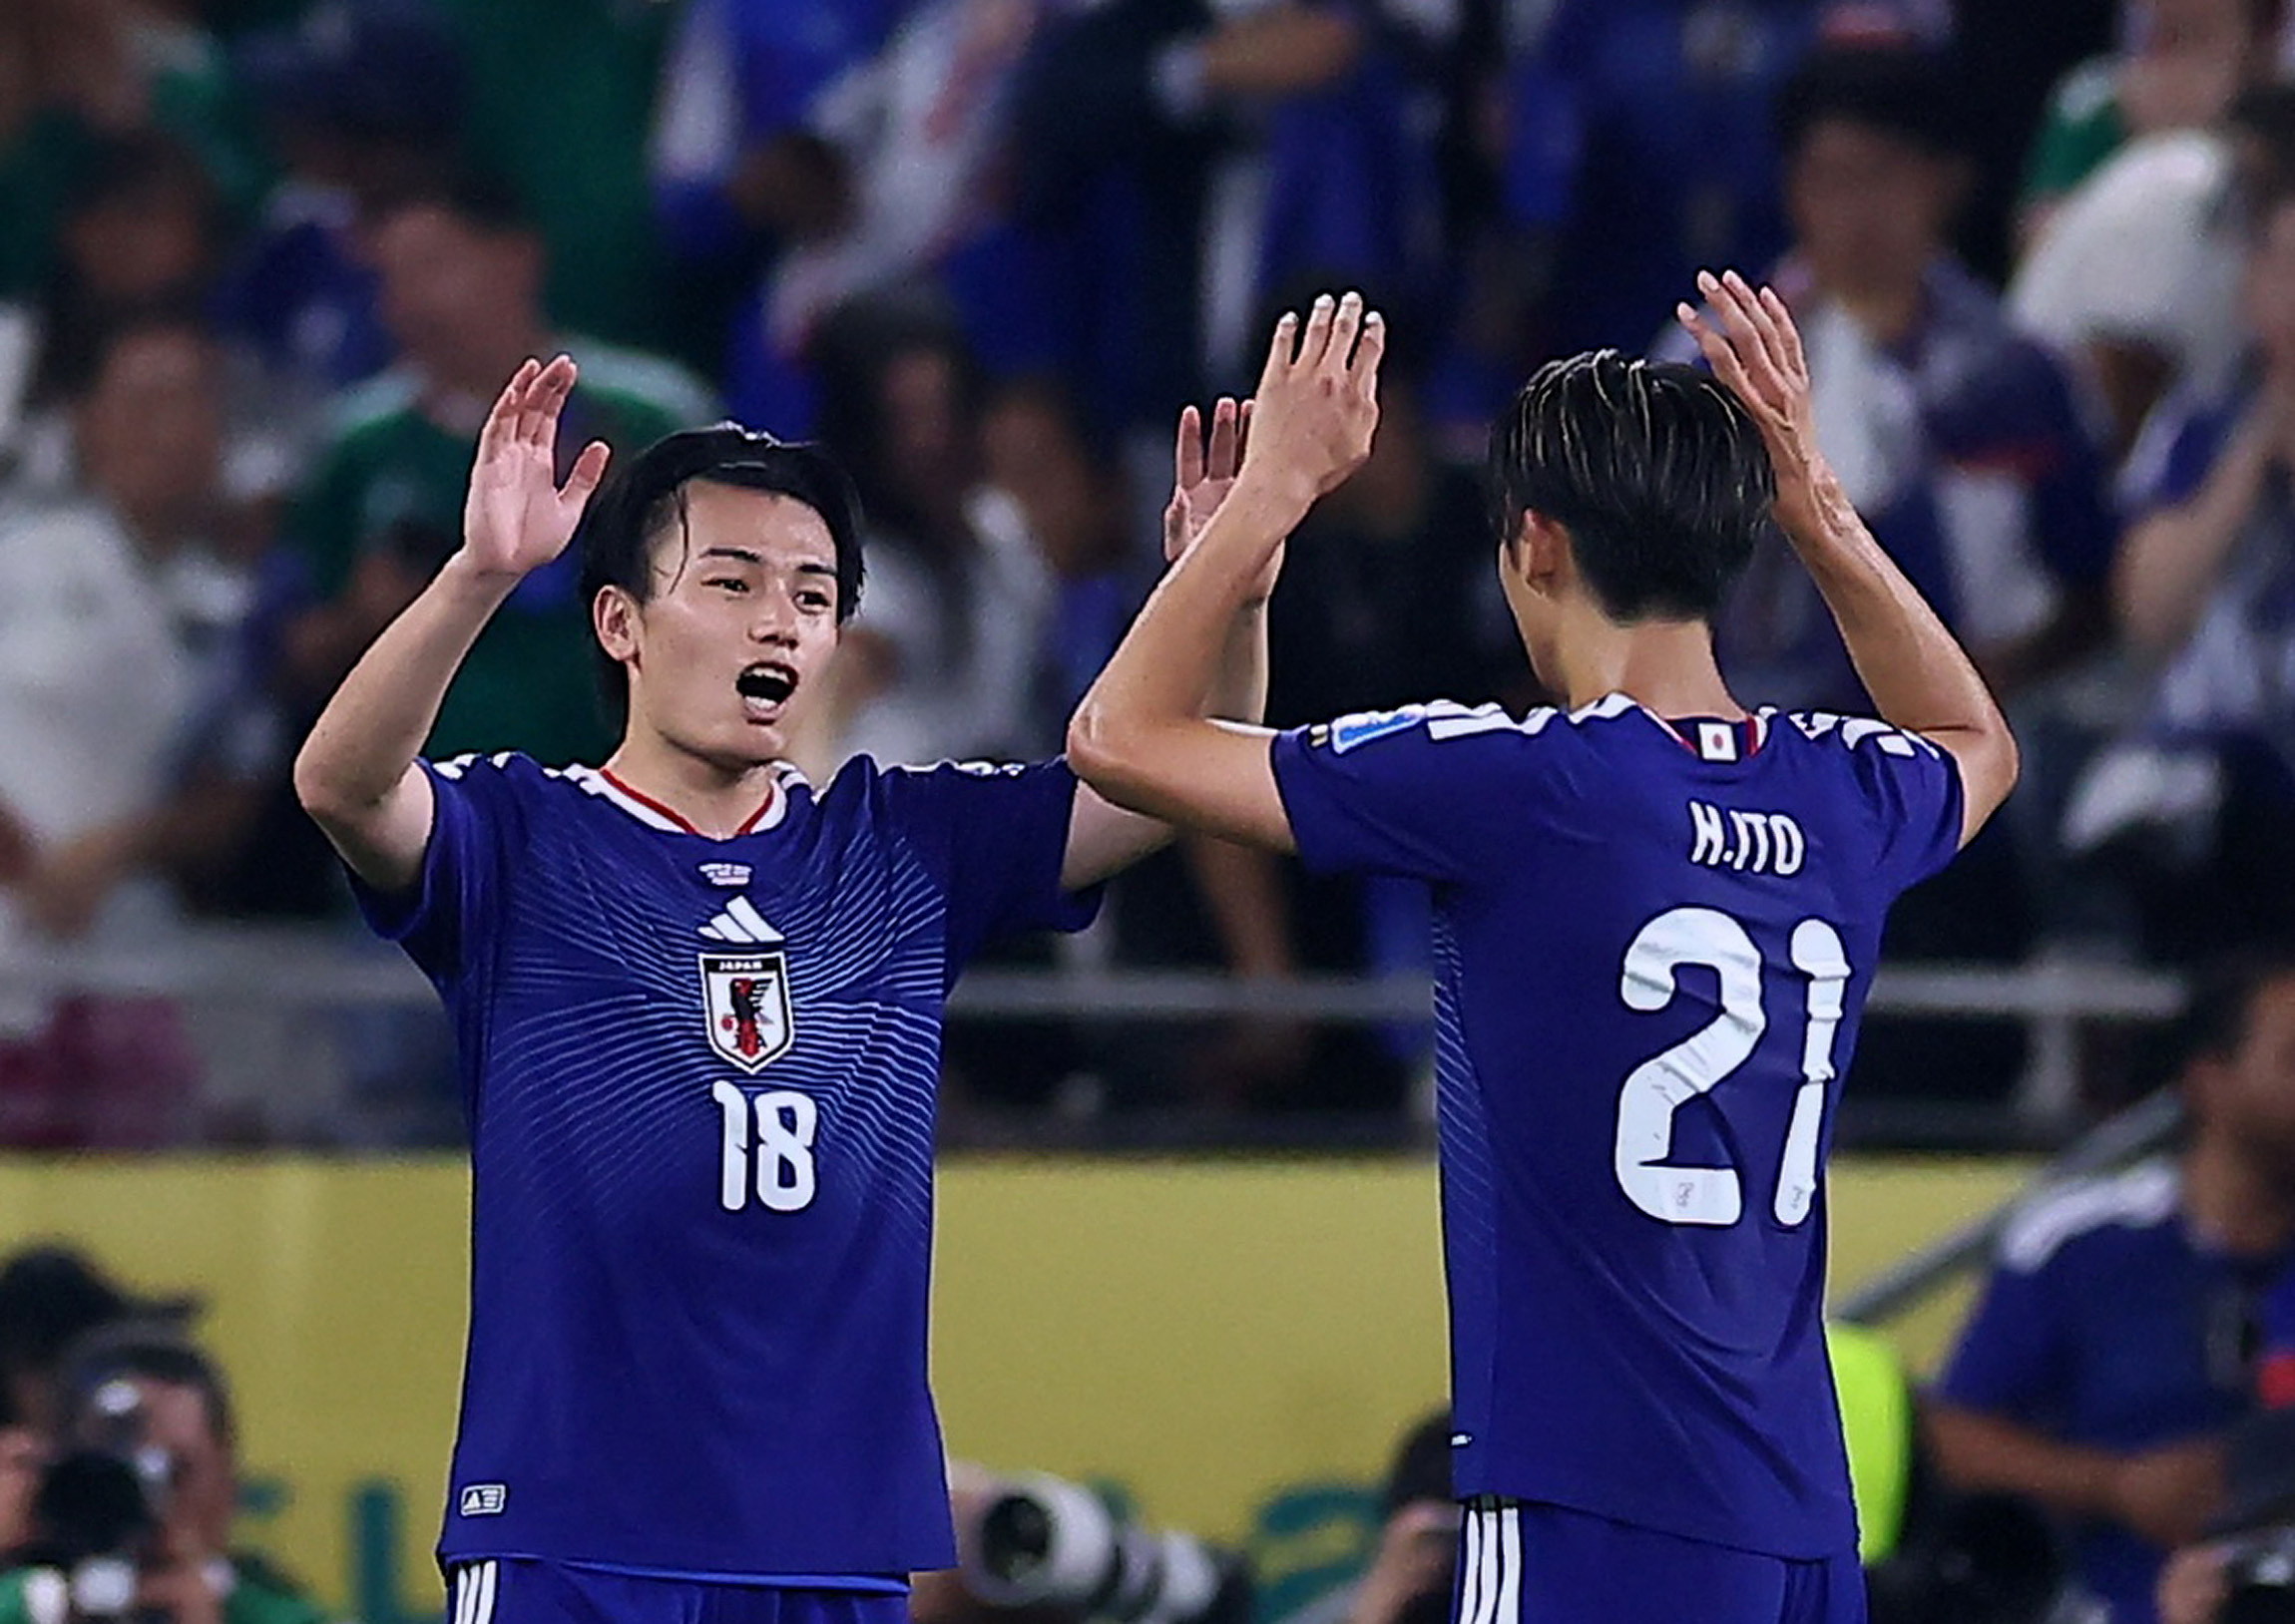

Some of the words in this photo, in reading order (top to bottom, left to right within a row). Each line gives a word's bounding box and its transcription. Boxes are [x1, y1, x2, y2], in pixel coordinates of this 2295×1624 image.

[1689, 802, 1804, 875] H.ITO
[718, 961, 763, 971] JAPAN
[1614, 907, 1851, 1227] 21
[711, 1079, 817, 1212] 18
